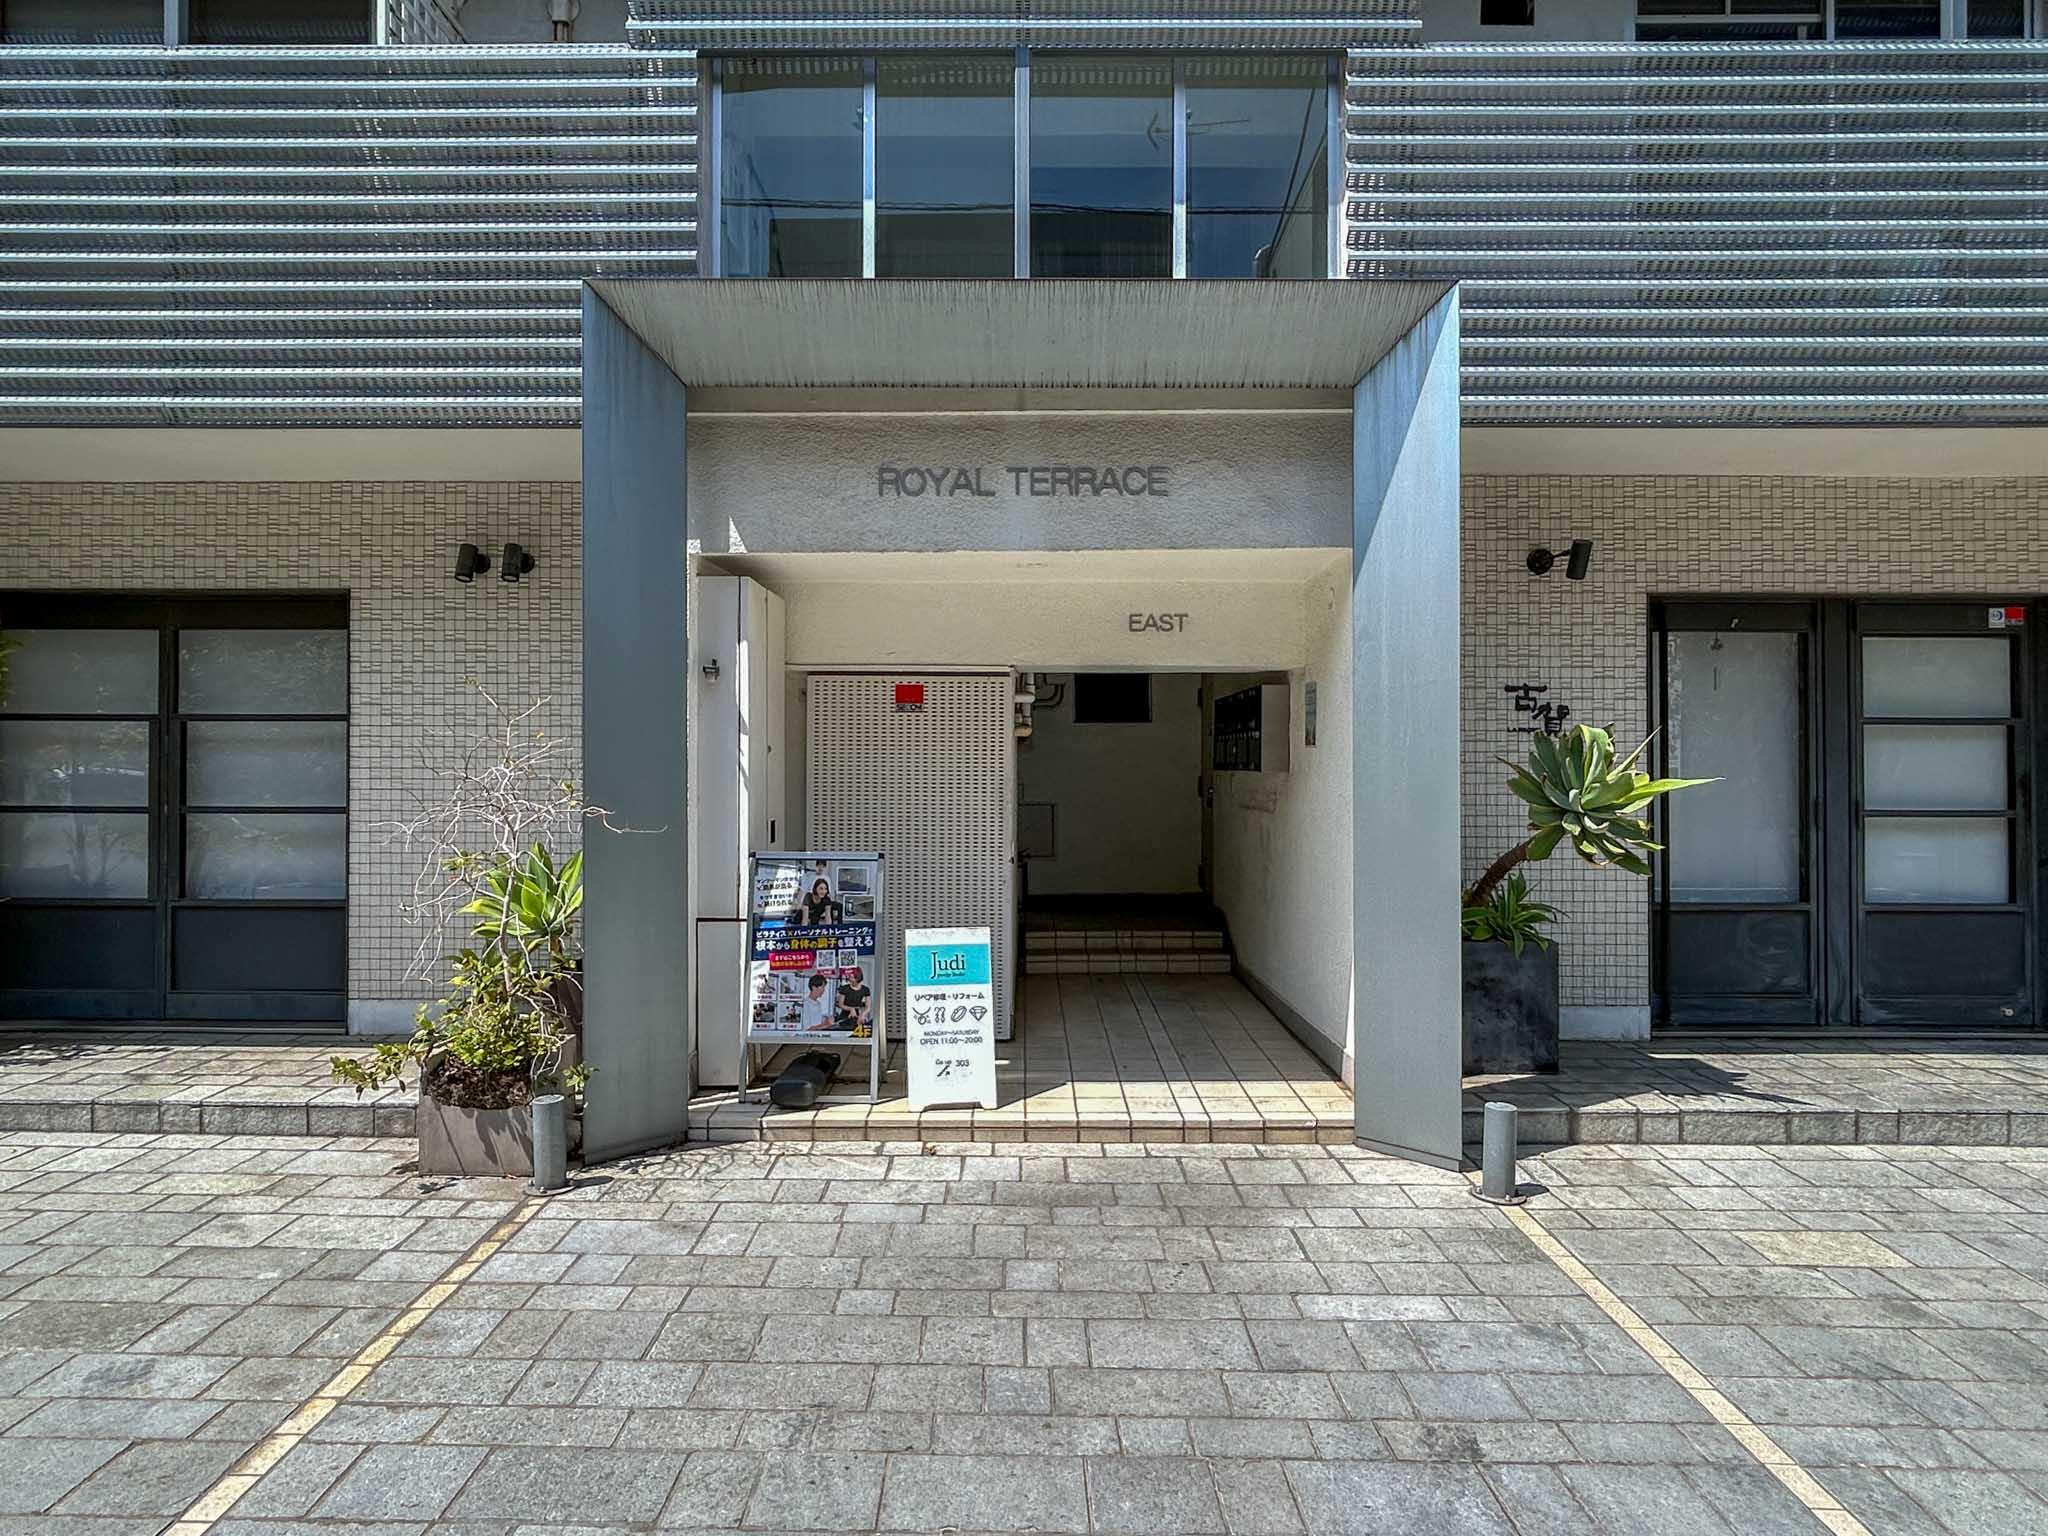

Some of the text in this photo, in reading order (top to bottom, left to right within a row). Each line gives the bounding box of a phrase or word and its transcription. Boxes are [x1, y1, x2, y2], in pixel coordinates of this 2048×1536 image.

[878, 466, 1169, 497] ROYAL TERRACE
[1129, 613, 1190, 633] EAST
[930, 951, 966, 980] Judi
[853, 1024, 872, 1038] 4F
[920, 1038, 939, 1046] OPEN
[955, 1058, 970, 1067] 303
